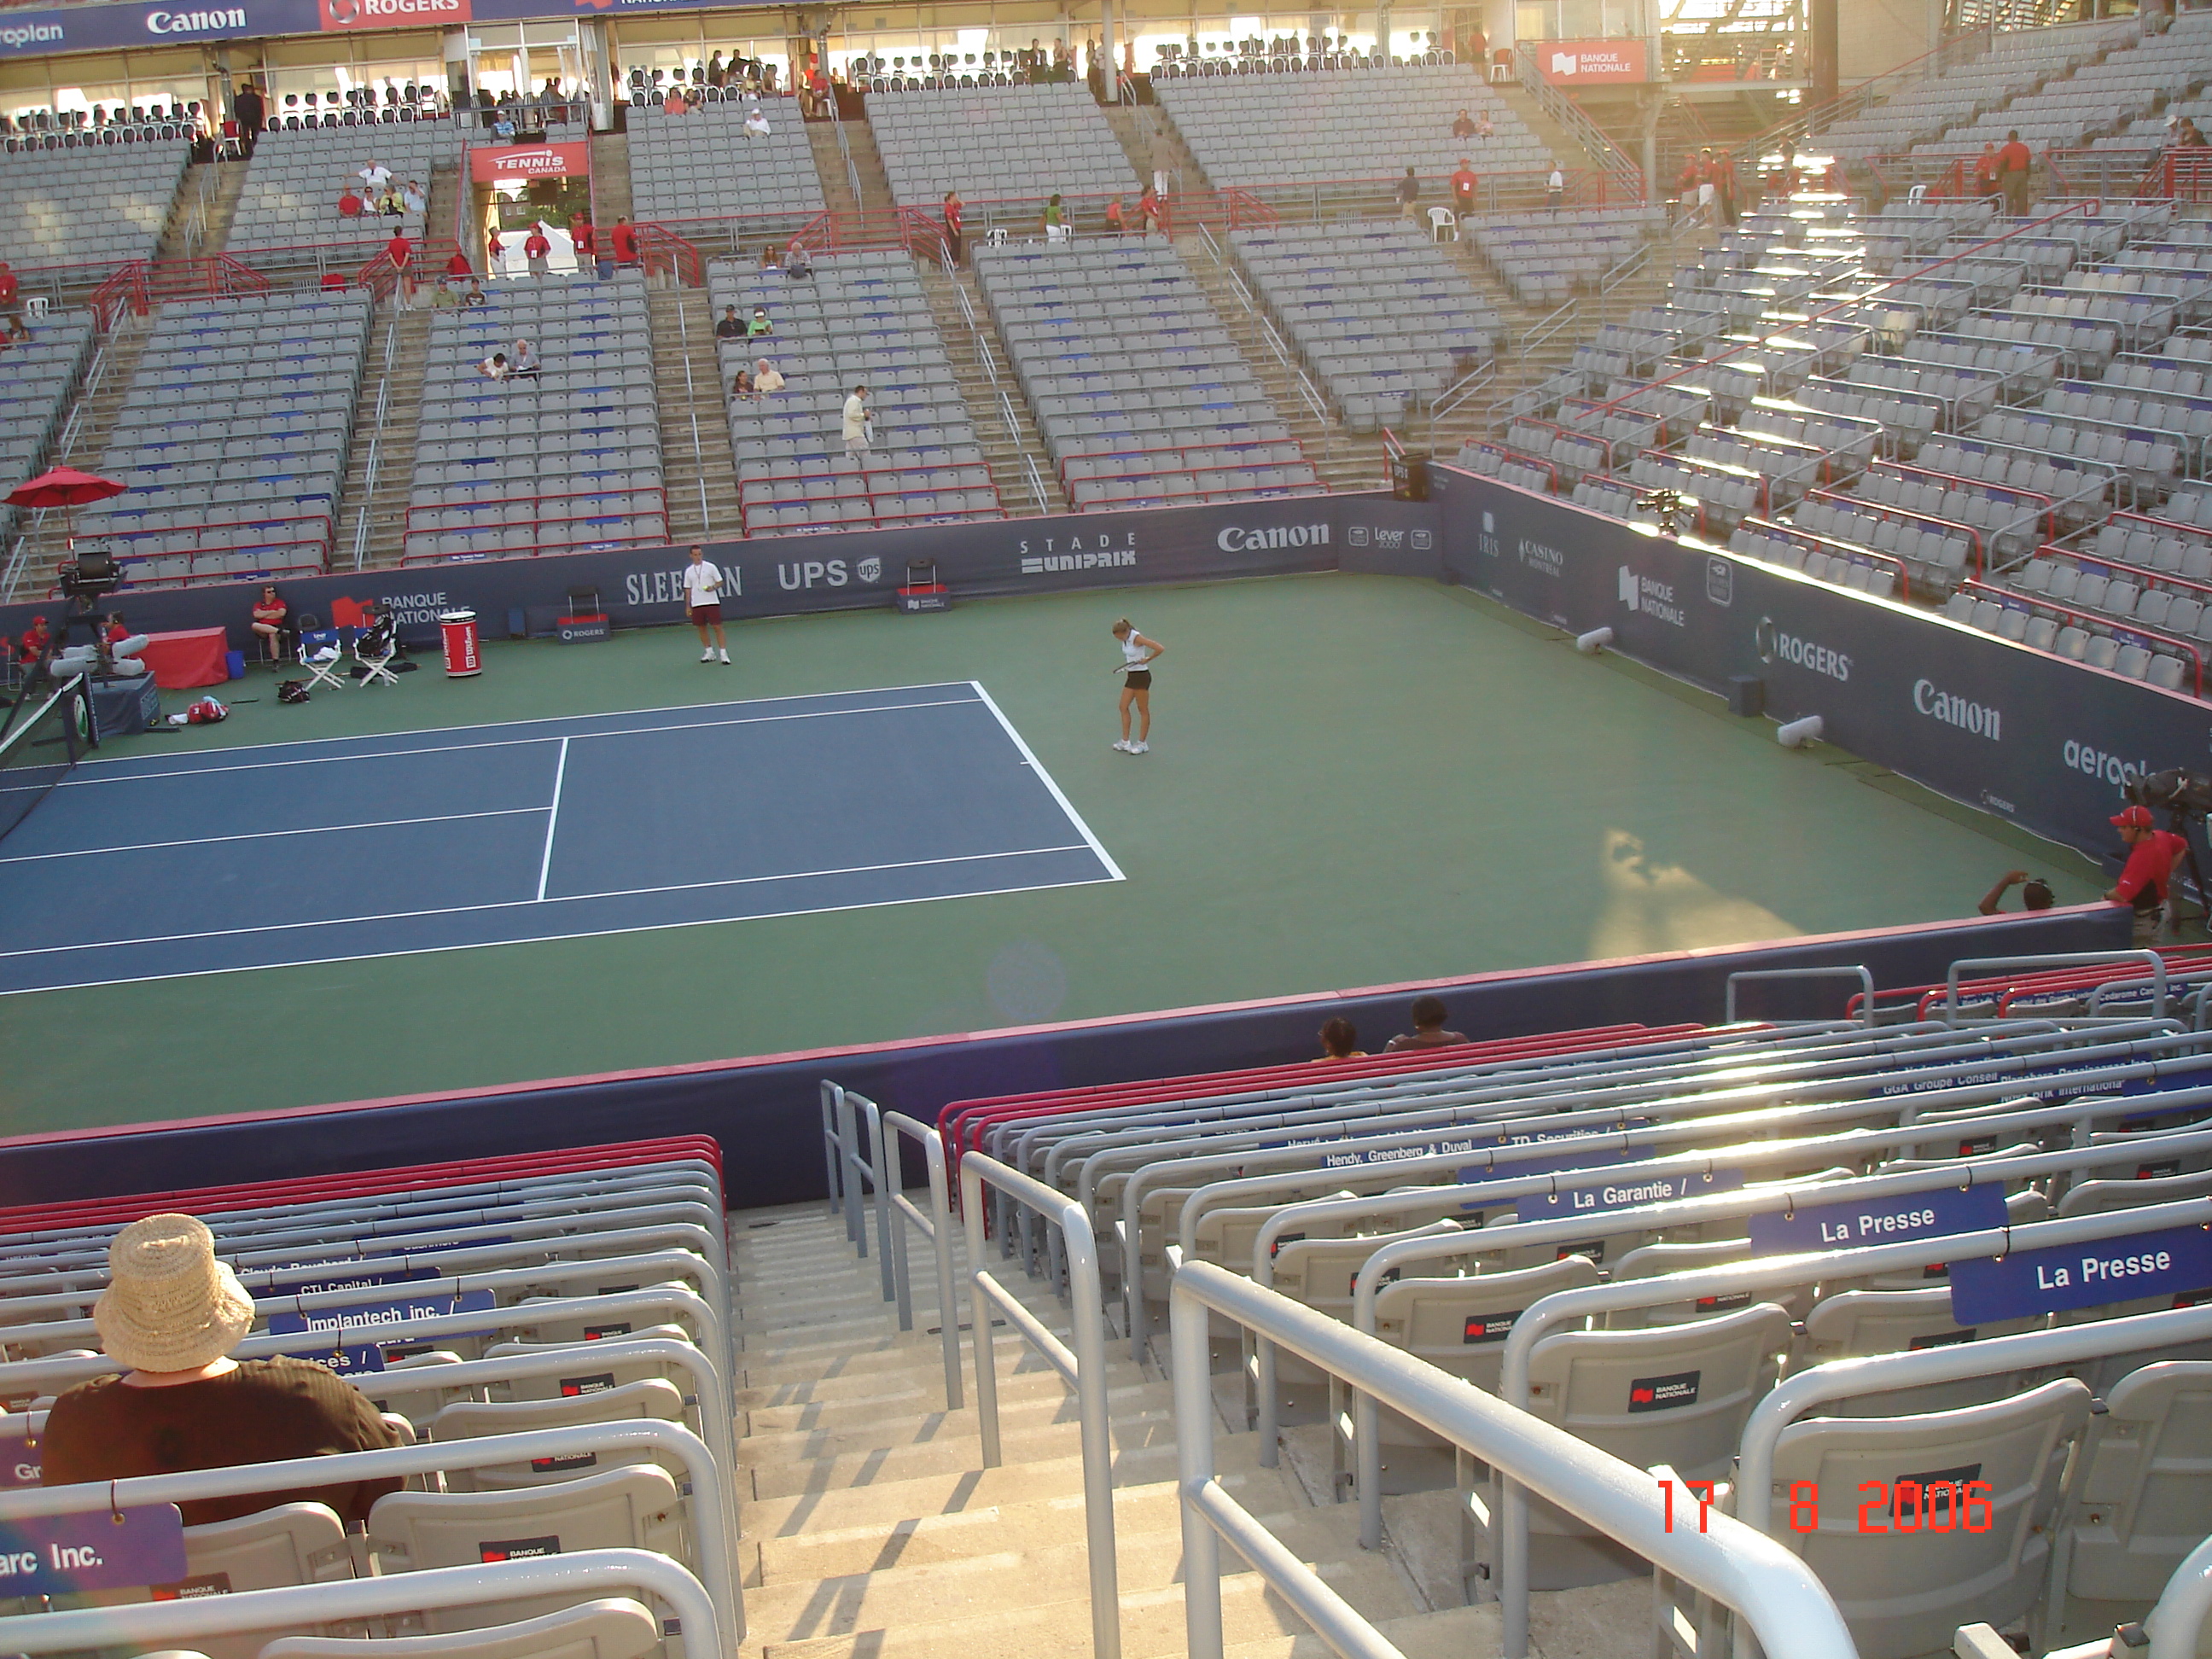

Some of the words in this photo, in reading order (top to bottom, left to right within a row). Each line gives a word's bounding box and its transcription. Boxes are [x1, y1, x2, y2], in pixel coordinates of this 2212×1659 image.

[147, 9, 246, 34] Canon
[1580, 53, 1618, 62] BANQUE
[1580, 63, 1631, 73] NATIONALE
[496, 156, 564, 169] TENNIS
[1217, 524, 1330, 552] Canon
[1374, 527, 1404, 541] Lever
[1479, 533, 1499, 557] IRIS
[1525, 540, 1563, 565] CASINO
[1044, 550, 1136, 572] UNIPRIX
[778, 560, 848, 591] UPS
[859, 563, 879, 579] ups
[626, 566, 742, 605] SLEEN
[1640, 577, 1673, 602] BANQUE
[382, 592, 447, 609] BANQUE
[1640, 597, 1685, 626] NATIONALE
[573, 629, 604, 637] ROGERS
[1780, 633, 1848, 681] ROGERS
[1914, 679, 2000, 741] Canon
[1914, 1076, 1953, 1089] Groupe
[1958, 1072, 1997, 1085] Conseil
[1368, 1146, 1423, 1161] Greenberg
[1429, 1144, 1436, 1155] &
[1441, 1139, 1472, 1153] Duval
[1574, 1191, 1595, 1208] La
[1603, 1181, 1673, 1205] Garantie
[1680, 1178, 1687, 1195] /
[1821, 1222, 1849, 1243] La
[1859, 1208, 1935, 1235] Presse
[2037, 1265, 2069, 1290] La
[2081, 1250, 2171, 1283] Presse
[328, 1278, 371, 1292] Capital
[306, 1307, 401, 1330] Implantech
[410, 1305, 440, 1318] inc.
[449, 1301, 454, 1315] /
[580, 1381, 604, 1389] BANQUE
[581, 1384, 614, 1394] NATIONALE
[1656, 1382, 1686, 1393] BANQUE
[1656, 1387, 1696, 1400] NATIONALE
[555, 1452, 592, 1462] NATIONALE
[15, 1464, 41, 1480] Gr
[51, 1543, 103, 1569] Inc.
[509, 1546, 544, 1557] BANQUE
[180, 1585, 215, 1595] BANQUE
